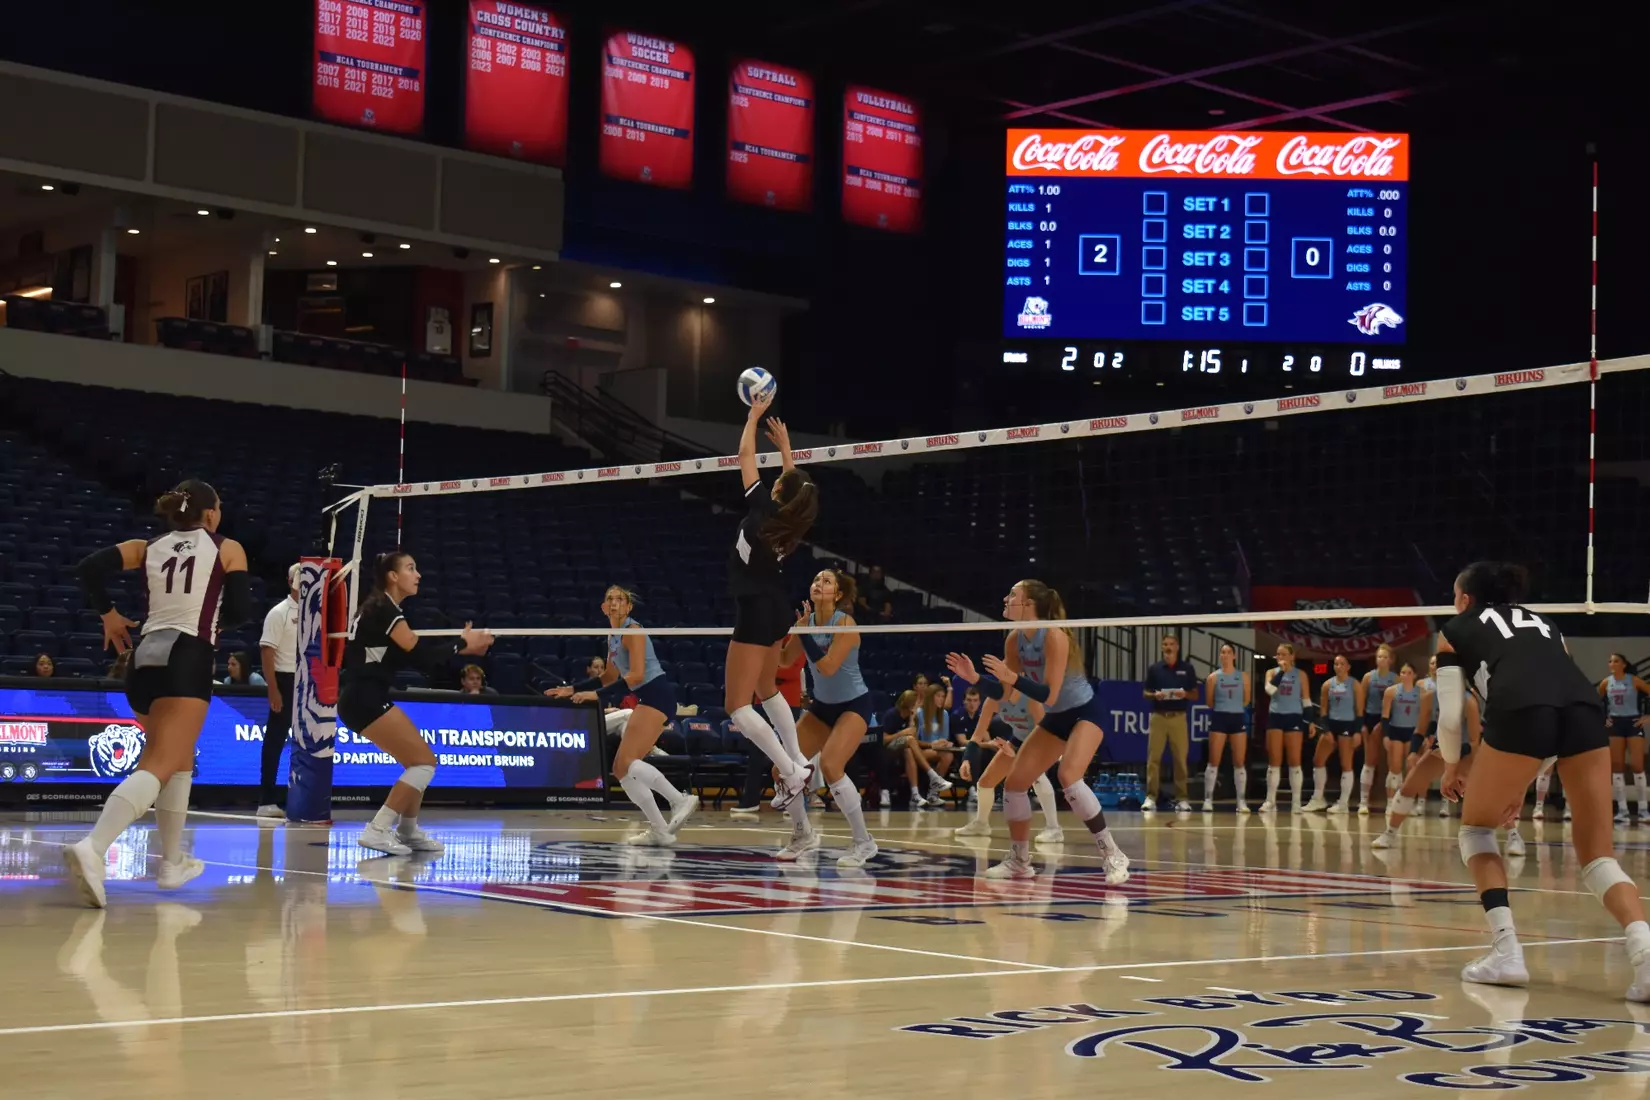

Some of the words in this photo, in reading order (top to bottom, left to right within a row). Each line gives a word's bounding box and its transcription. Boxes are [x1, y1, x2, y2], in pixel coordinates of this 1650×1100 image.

[373, 11, 395, 24] 2007
[497, 2, 549, 23] WOMEN'S
[318, 12, 341, 24] 2017
[346, 17, 368, 29] 2018
[373, 23, 395, 36] 2019
[477, 11, 512, 28] CROSS
[515, 19, 566, 39] COUNTRY
[318, 23, 341, 36] 2021
[345, 29, 368, 42] 2022
[372, 34, 394, 47] 2023
[480, 27, 521, 43] CONFERENCE
[522, 36, 559, 50] CHAMPIONS
[627, 32, 675, 53] WOMEN'S
[631, 46, 670, 64] SOCCER
[336, 55, 355, 67] NCAA
[356, 59, 404, 75] TOURNAMENT
[612, 57, 650, 72] CONFERENCE
[317, 62, 340, 76] 2007
[372, 73, 394, 86] 2017
[748, 66, 797, 87] SOFTBALL
[344, 79, 366, 93] 2021
[371, 85, 394, 98] 2022
[738, 86, 773, 100] CONFERENCE
[856, 92, 914, 114] VOLLEYBALL
[619, 117, 635, 128] NCAA
[636, 121, 675, 136] TOURNAMENT
[761, 147, 798, 161] TOURNAMENT
[1012, 134, 1126, 171] Coca-Cola
[1138, 134, 1263, 174] Coca-Cola
[1276, 136, 1401, 176] Coca-Cola
[1009, 184, 1035, 194] ATT%
[1039, 185, 1060, 195] 1.00
[1347, 189, 1373, 198] ATT%
[1377, 190, 1400, 200] .000
[1009, 203, 1035, 212] KILLS
[1046, 203, 1051, 213] 1
[1183, 197, 1217, 211] SET
[1221, 198, 1230, 211] 1
[1347, 207, 1374, 217] KILLS
[1384, 208, 1392, 218] 0
[1008, 221, 1033, 231] BLKS
[1040, 222, 1057, 232] 0.0
[1183, 225, 1217, 238] SET
[1220, 225, 1231, 239] 2
[1347, 226, 1372, 235] BLKS
[1379, 226, 1396, 236] 0.0
[1007, 240, 1034, 249] ACES
[1045, 240, 1051, 249] 1
[1346, 245, 1373, 254] ACES
[1383, 244, 1391, 255] 0
[1094, 244, 1108, 263] 2
[1182, 252, 1216, 266] SET
[1219, 252, 1231, 266] 3
[1306, 247, 1320, 266] 0
[1008, 259, 1031, 268] DIGS
[1045, 258, 1051, 267] 1
[1346, 264, 1369, 273] DIGS
[1383, 262, 1391, 273] 0
[1007, 277, 1032, 286] ASTS
[1044, 276, 1050, 285] 1
[1182, 279, 1216, 293] SET
[1219, 280, 1230, 294] 4
[1346, 282, 1371, 291] ASTS
[1383, 281, 1391, 291] 0
[1181, 306, 1215, 320] SET
[1218, 307, 1230, 321] 5
[1062, 347, 1078, 370] 2
[1094, 352, 1105, 368] 0
[1111, 352, 1124, 368] 2
[1183, 350, 1221, 373] 1:15
[1241, 359, 1247, 373] 1
[1283, 356, 1294, 371] 2
[1310, 357, 1321, 372] 0
[1350, 352, 1365, 376] 0
[1495, 371, 1545, 386] BRUINS
[1383, 384, 1427, 399] BELMONT
[1278, 396, 1320, 411] BRUINS
[1182, 407, 1219, 421] BELMONT
[1090, 417, 1127, 431] BRUINS
[927, 436, 958, 448] BRUINS
[1007, 428, 1040, 441] BELMONT
[791, 450, 812, 460] UINS
[854, 443, 880, 455] BELMONT
[655, 463, 681, 474] BRUINS
[718, 456, 741, 468] BELMON
[542, 473, 565, 483] BRUINS
[598, 468, 621, 478] BELMONT
[440, 481, 461, 491] BRUINS
[161, 556, 196, 594] 11
[1479, 608, 1551, 640] 14
[1613, 695, 1625, 706] 21
[438, 729, 586, 749] TRANSPORTATION
[440, 754, 493, 766] BELMONT
[494, 756, 535, 767] BRUINS
[898, 1003, 1163, 1038] RICK
[1138, 990, 1440, 1010] BYRD
